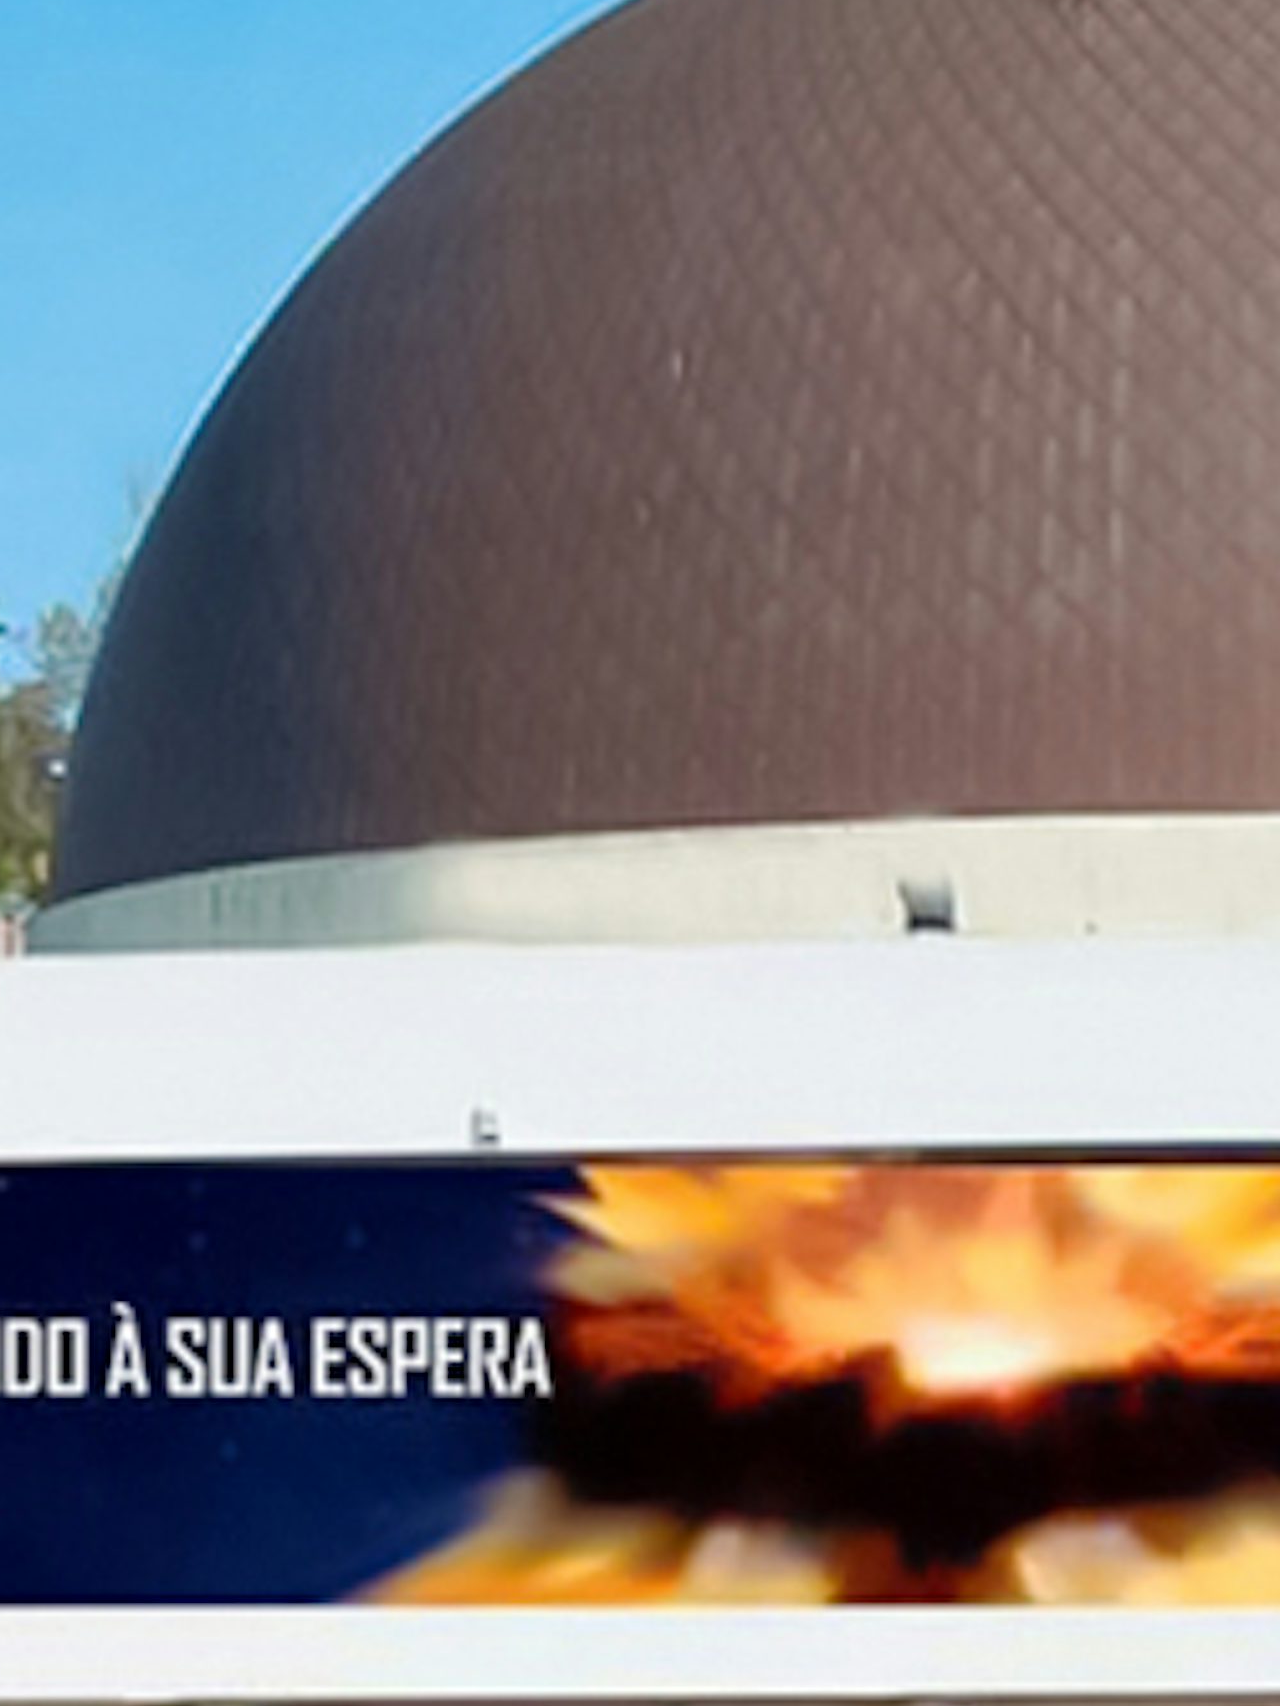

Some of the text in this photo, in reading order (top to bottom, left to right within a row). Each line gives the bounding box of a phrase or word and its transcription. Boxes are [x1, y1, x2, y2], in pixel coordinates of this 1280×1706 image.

[106, 1302, 151, 1398] À
[167, 1317, 295, 1398] SUA
[312, 1317, 552, 1398] ESPERA
